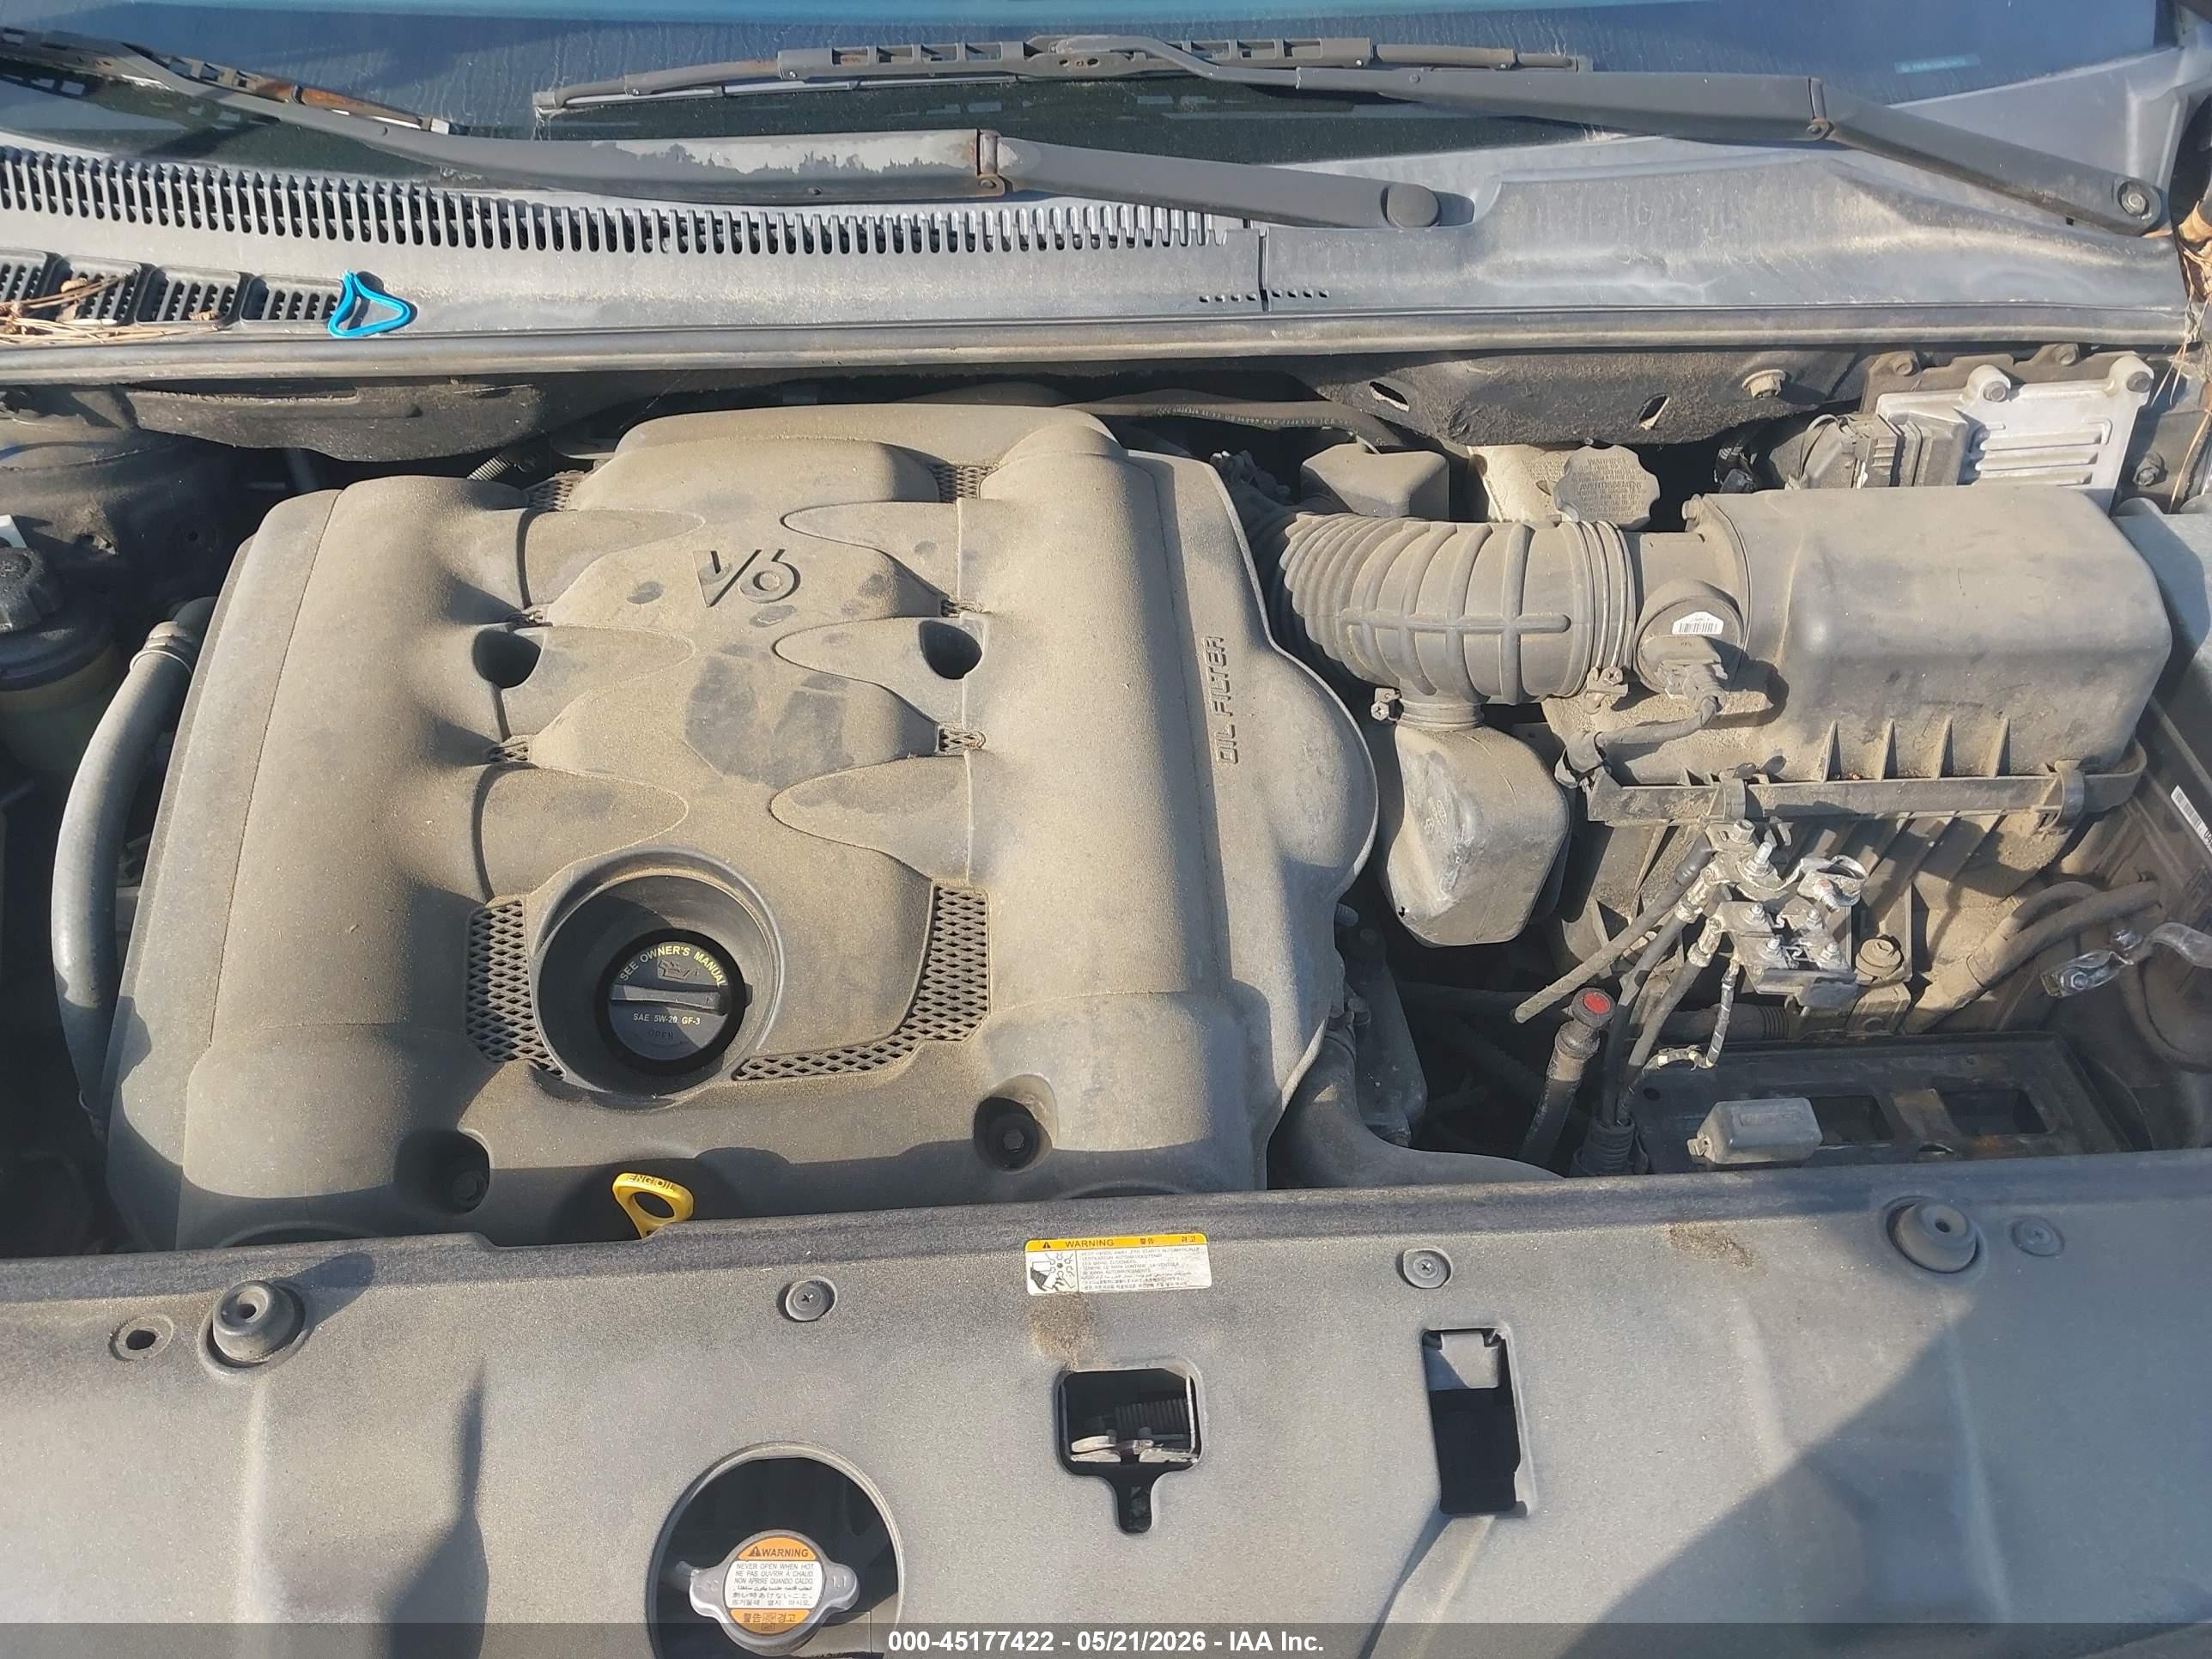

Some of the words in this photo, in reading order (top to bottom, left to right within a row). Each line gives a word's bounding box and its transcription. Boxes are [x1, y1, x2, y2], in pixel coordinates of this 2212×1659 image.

[693, 549, 801, 608] V6
[1203, 635, 1233, 717] FILTER
[1213, 724, 1238, 764] OIL
[619, 961, 639, 981] SEE
[640, 945, 691, 963] OWNER'S
[693, 951, 727, 988] MANUAL
[633, 1013, 650, 1022] SAE
[653, 1014, 678, 1024] 5W-20
[681, 1016, 701, 1025] GF-3
[655, 1180, 674, 1192] OIL
[1065, 1238, 1115, 1248] WARNING
[762, 1547, 809, 1558] WARNING
